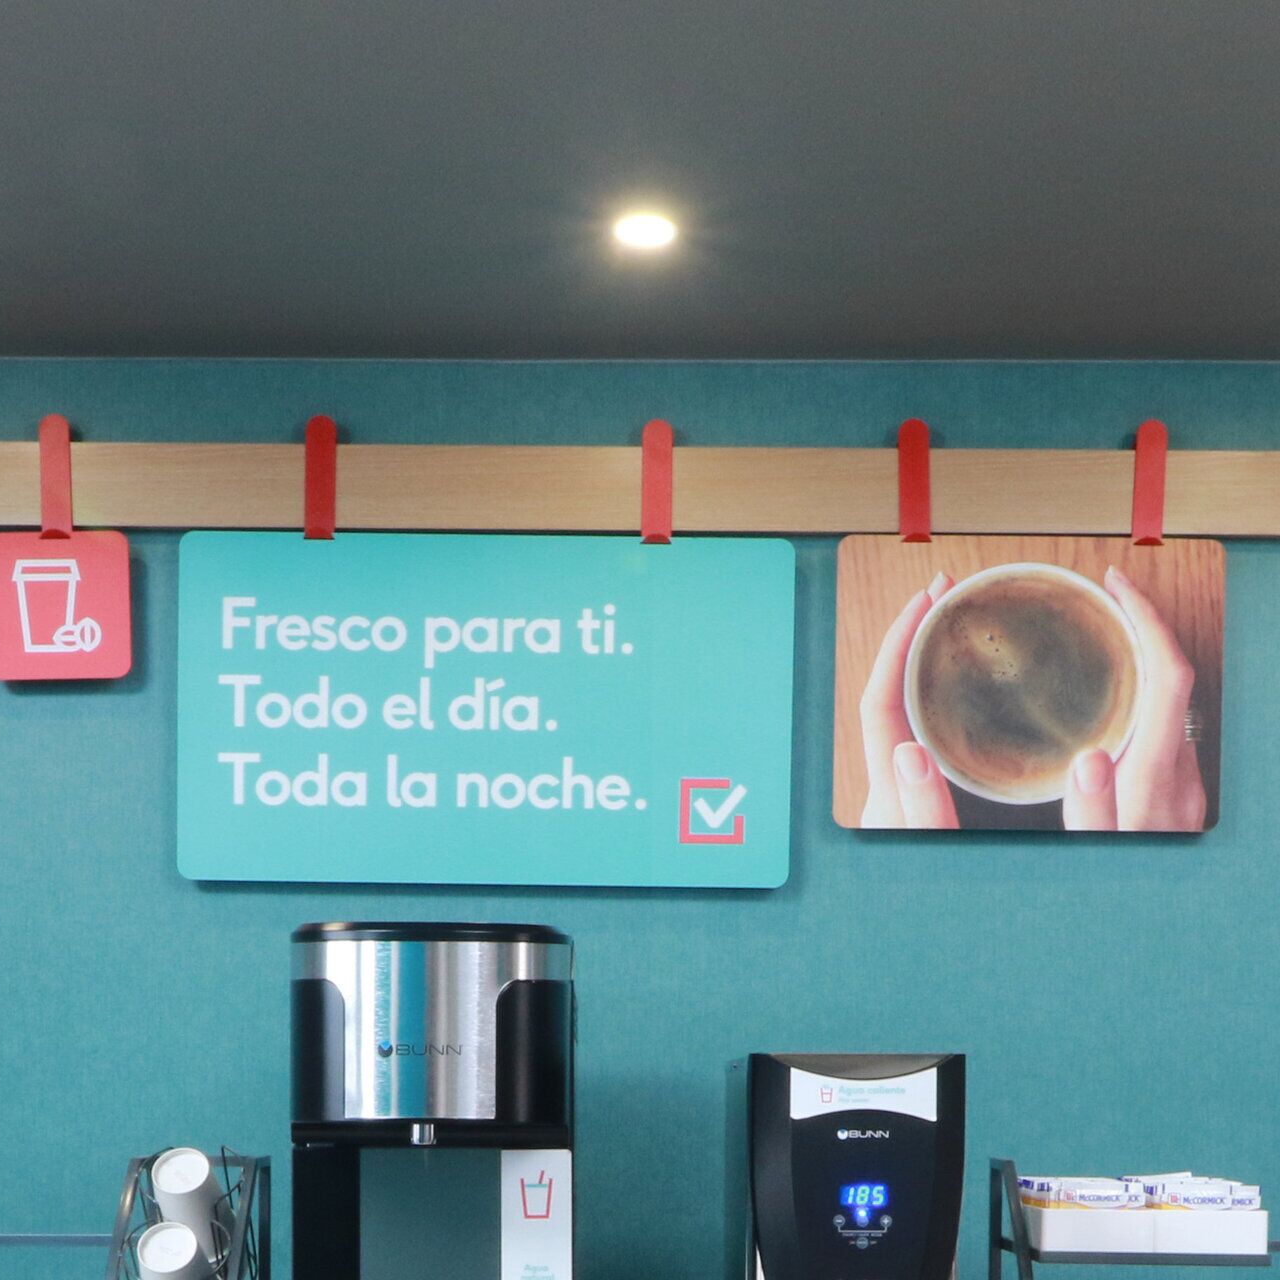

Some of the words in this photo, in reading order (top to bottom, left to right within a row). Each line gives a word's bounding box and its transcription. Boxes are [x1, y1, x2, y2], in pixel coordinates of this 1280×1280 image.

[221, 597, 407, 653] Fresco
[424, 611, 560, 668] para
[577, 604, 634, 655] ti.
[218, 674, 366, 729] Todo
[382, 677, 434, 730] el
[448, 677, 558, 731] día.
[218, 752, 367, 807] Toda
[387, 754, 437, 808] la
[456, 756, 646, 810] noche.
[395, 1043, 463, 1056] BUNN
[848, 1129, 890, 1139] BUNN
[847, 1185, 885, 1206] 185
